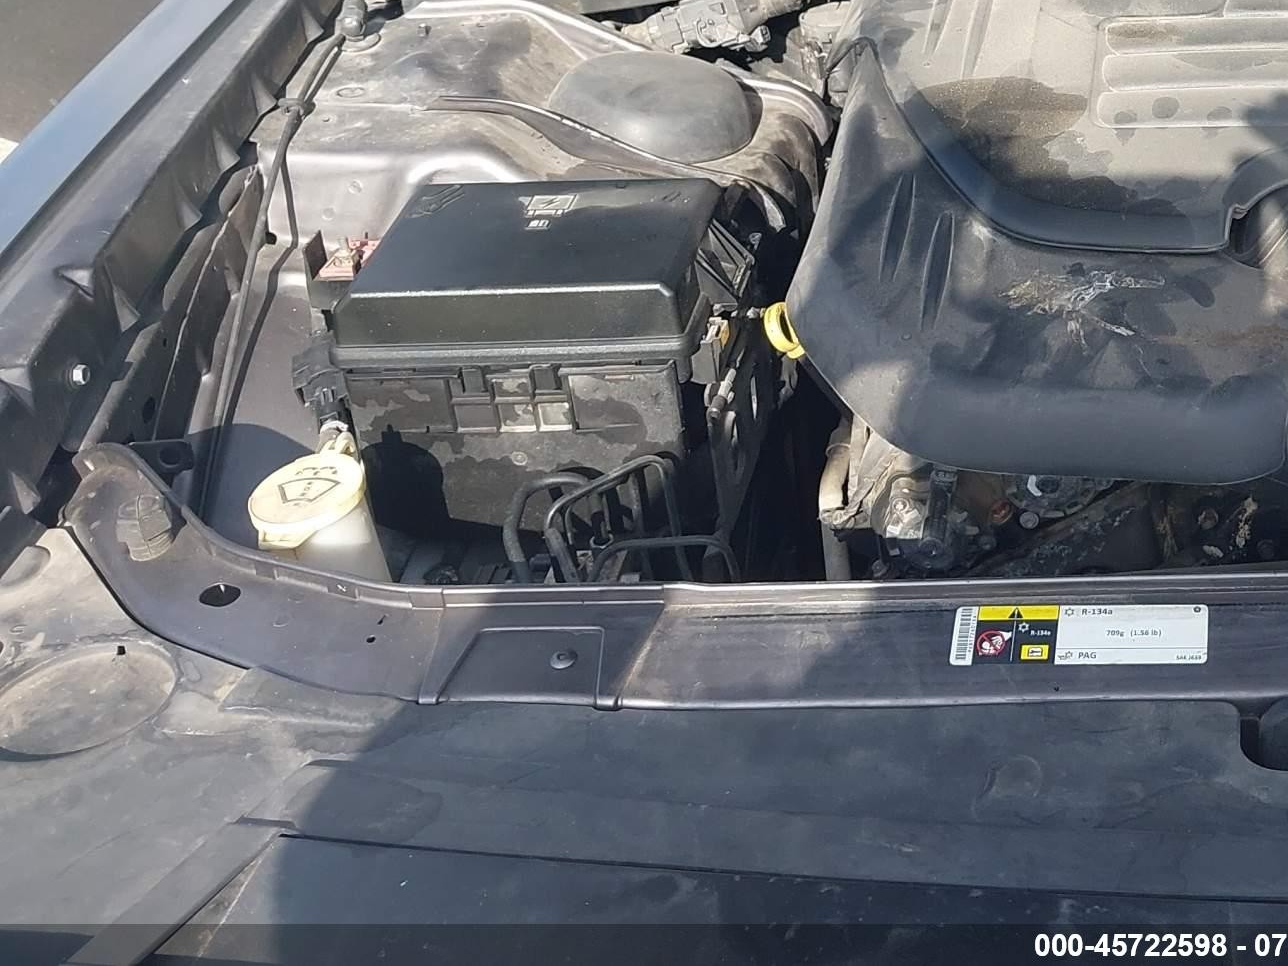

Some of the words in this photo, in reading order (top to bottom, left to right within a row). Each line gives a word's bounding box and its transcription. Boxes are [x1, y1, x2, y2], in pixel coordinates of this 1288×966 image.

[1081, 608, 1113, 616] R-134a
[1106, 629, 1125, 638] 709g
[1078, 651, 1098, 660] PAG
